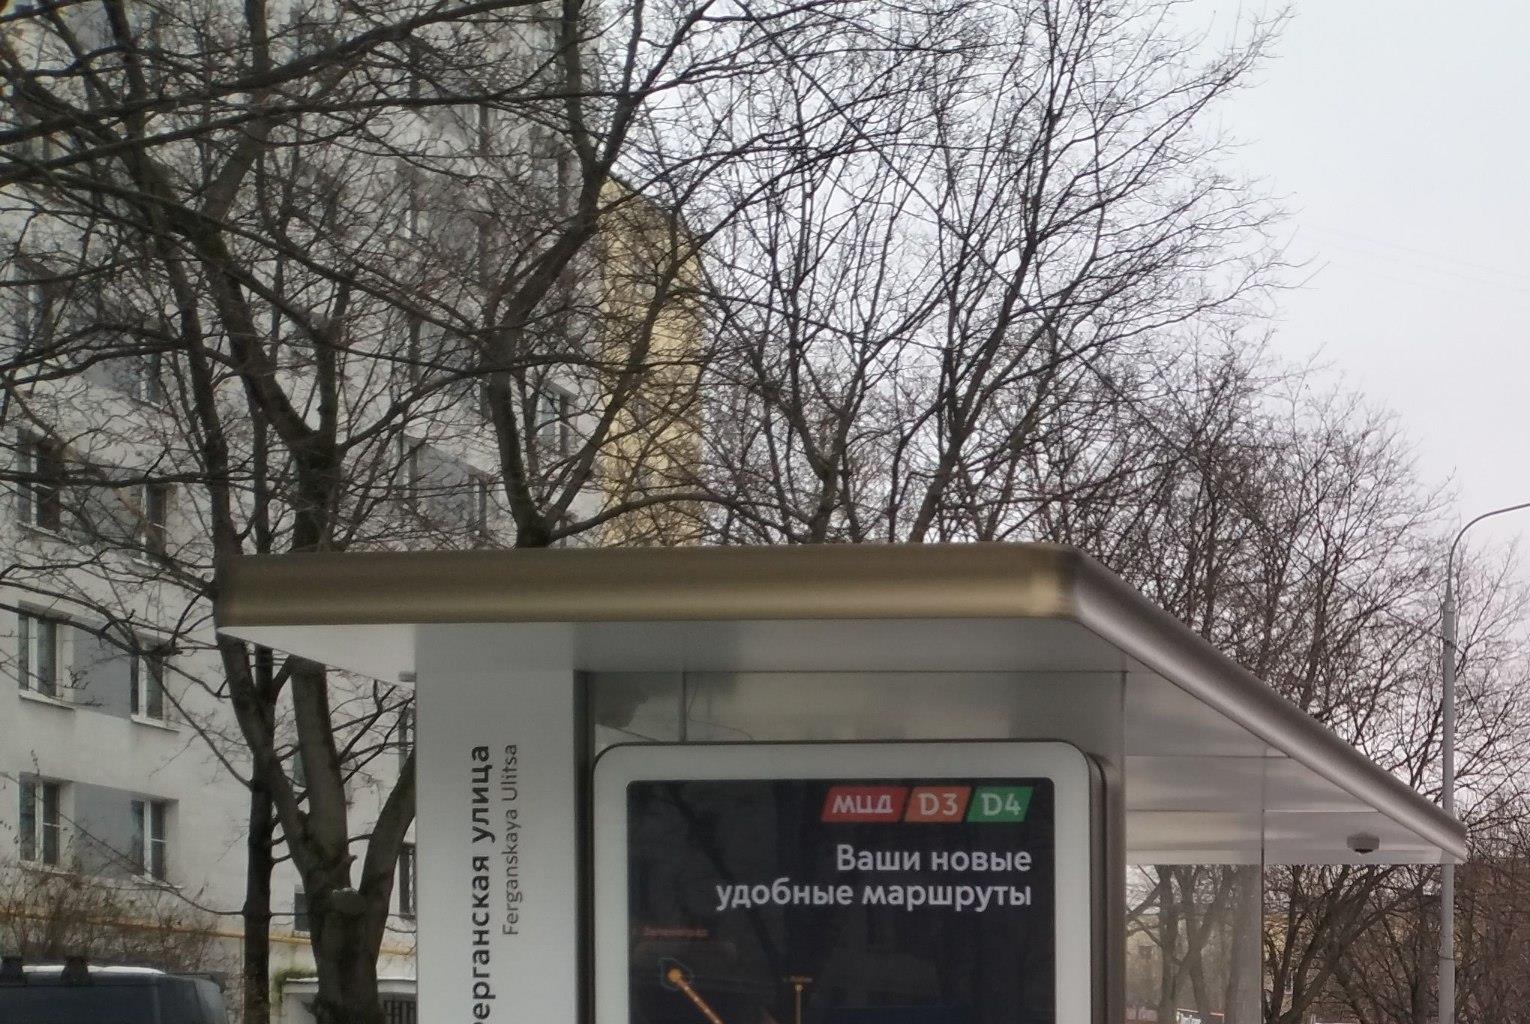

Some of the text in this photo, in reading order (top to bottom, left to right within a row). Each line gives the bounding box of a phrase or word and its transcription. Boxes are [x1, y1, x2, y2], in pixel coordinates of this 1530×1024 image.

[471, 745, 496, 844] улица
[831, 792, 1022, 816] МЦД D3 D4
[500, 744, 523, 936] Ferganskaya Ulitsa
[836, 843, 1033, 872] Ваши новые
[715, 877, 1032, 912] удобные маршруты
